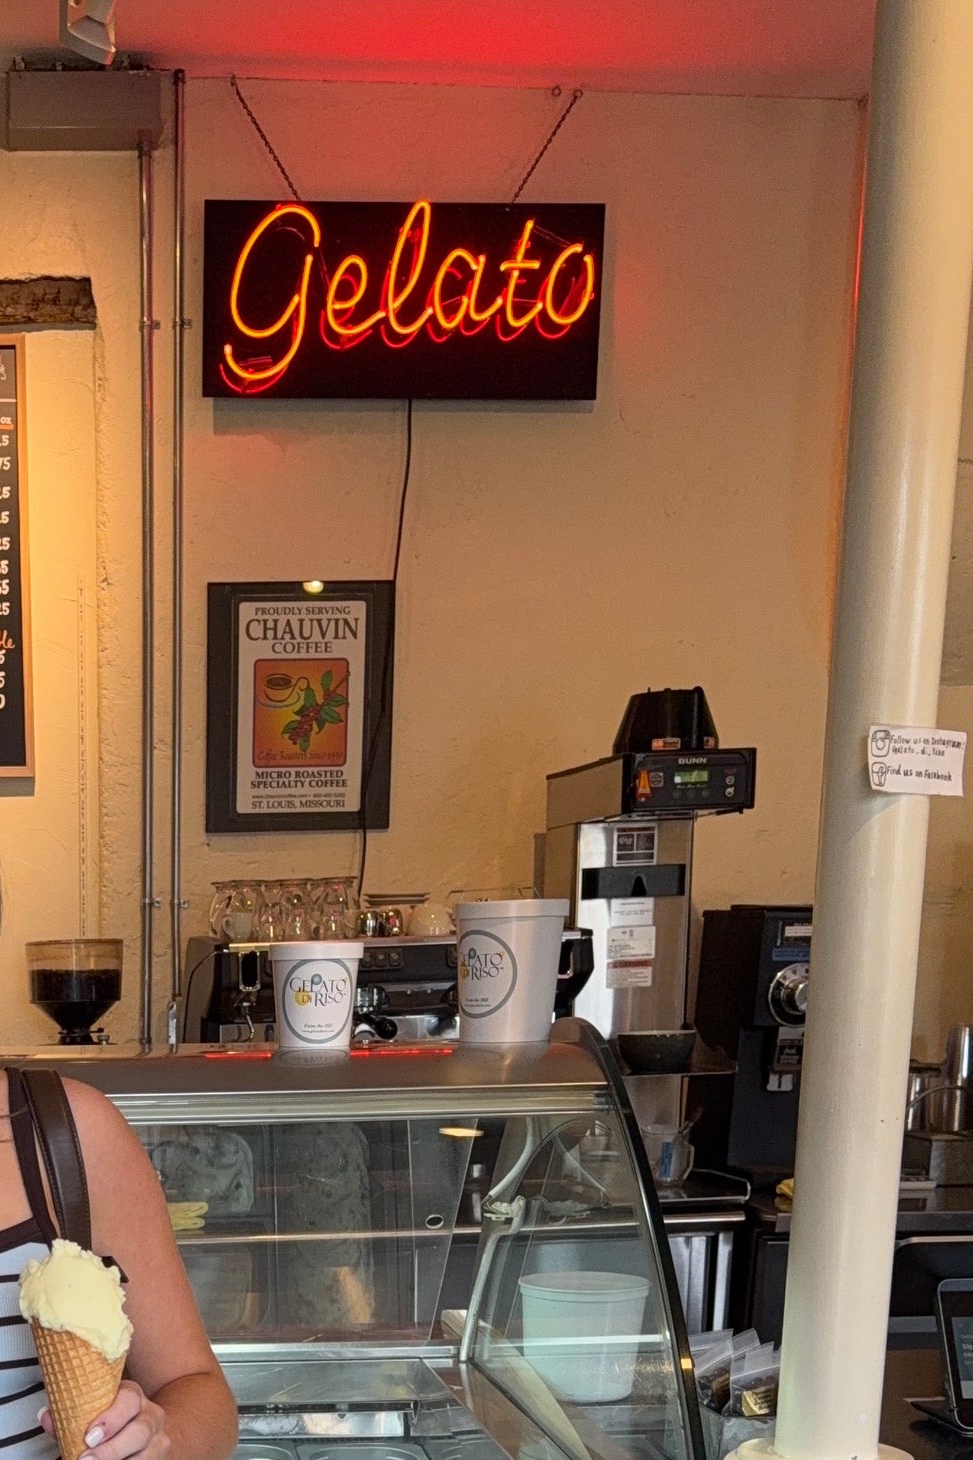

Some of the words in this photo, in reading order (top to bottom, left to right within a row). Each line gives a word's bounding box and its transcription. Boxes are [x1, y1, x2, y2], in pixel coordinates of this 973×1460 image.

[223, 199, 595, 382] Gelato
[255, 606, 303, 616] PROUDLY
[305, 606, 351, 616] SERVING
[245, 617, 359, 641] CHAUVIN
[271, 641, 333, 654] COFFEE
[890, 735, 911, 745] Follow
[678, 757, 707, 765] BUNN
[255, 770, 291, 780] MICRO
[294, 769, 344, 779] ROASTED
[887, 764, 901, 775] Find
[903, 769, 913, 777] us
[924, 769, 952, 782] Facebook
[250, 780, 306, 790] SPECIALTY
[308, 779, 347, 789] COFFEE
[252, 800, 264, 810] ST.
[267, 800, 297, 810] LOUIS,
[299, 799, 345, 809] MISSOURI
[471, 966, 500, 981] RISO
[289, 974, 346, 993] GELATO
[314, 992, 343, 1007] RISO
